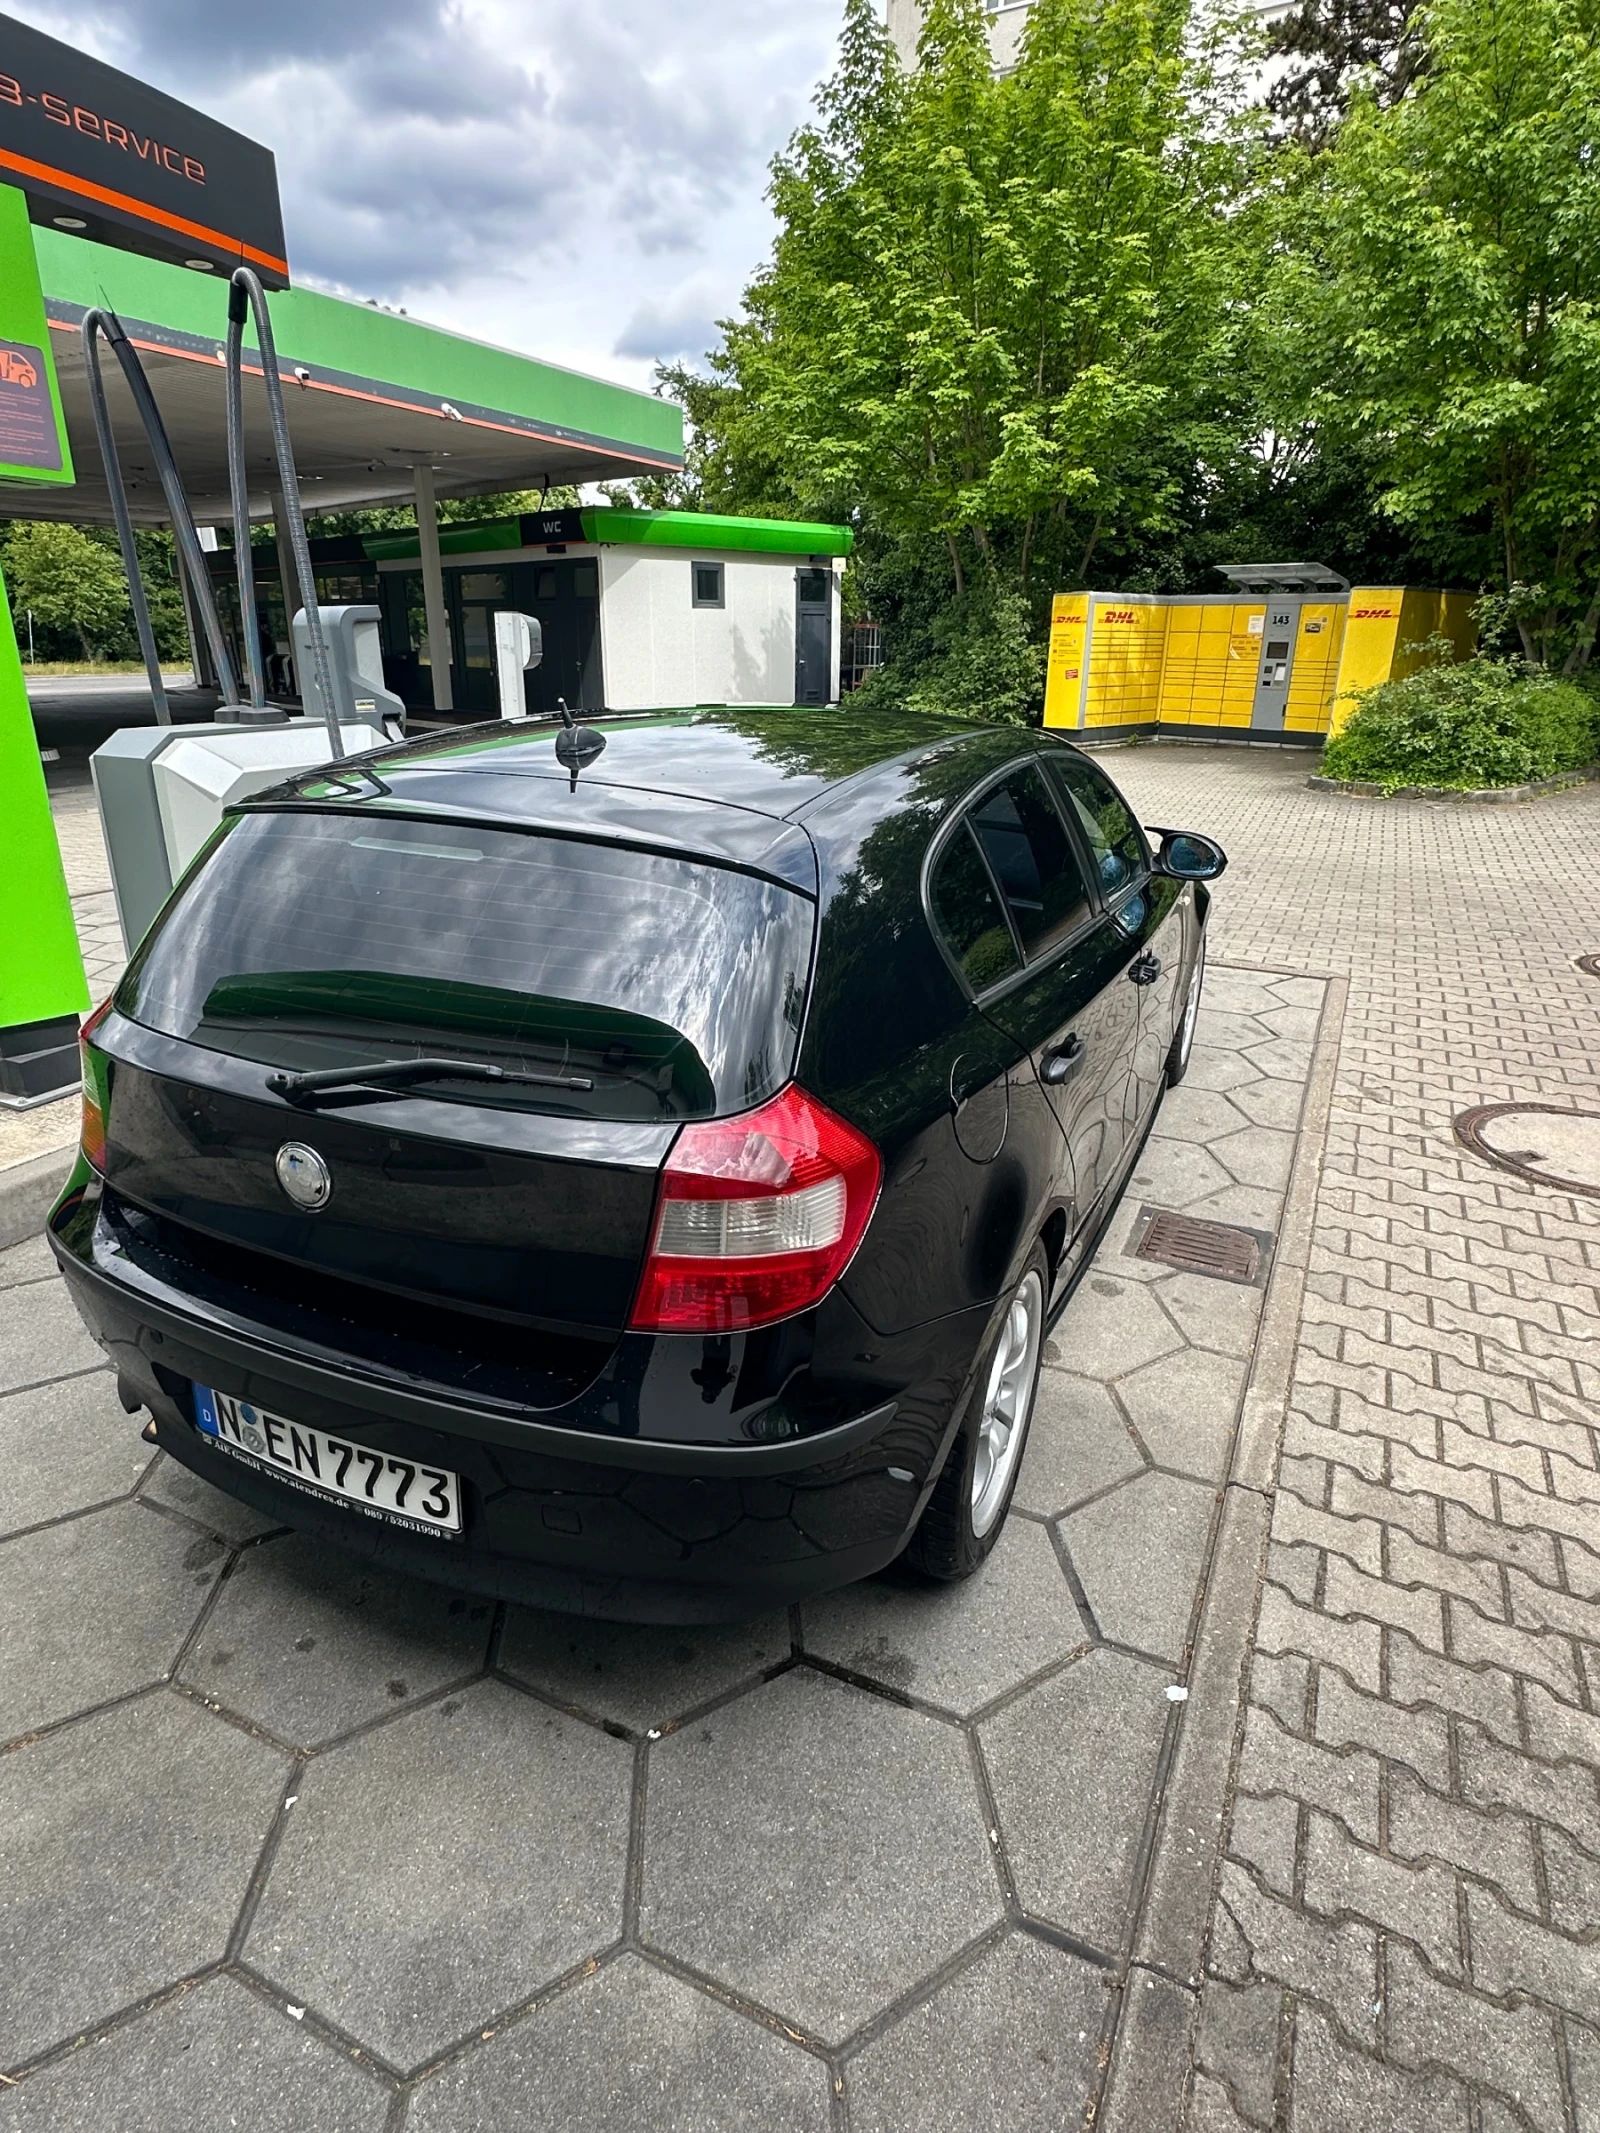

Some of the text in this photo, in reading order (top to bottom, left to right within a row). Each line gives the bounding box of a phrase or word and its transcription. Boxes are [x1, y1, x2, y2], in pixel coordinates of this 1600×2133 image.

[542, 520, 562, 534] WC
[1055, 616, 1083, 624] DHL
[1104, 611, 1136, 624] DHL
[1272, 615, 1290, 625] 143
[1354, 609, 1393, 618] DHL
[203, 1408, 211, 1422] D
[214, 1391, 241, 1443] N
